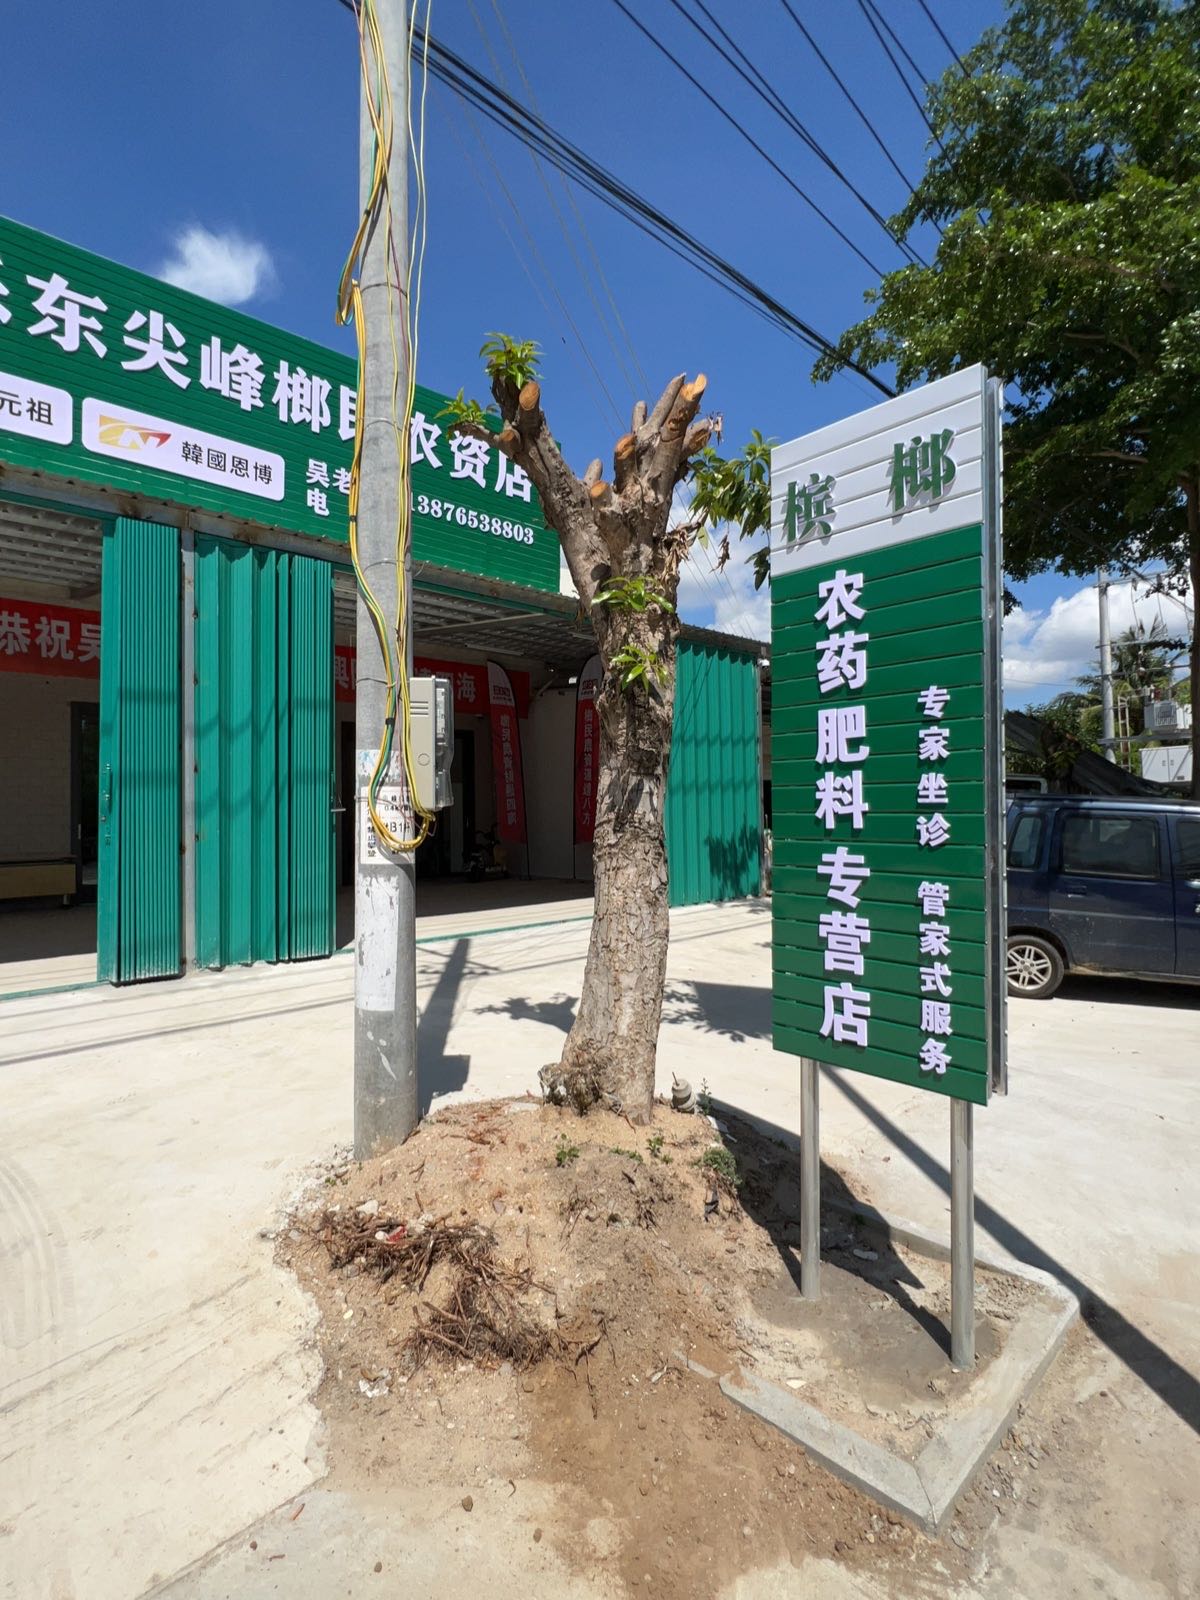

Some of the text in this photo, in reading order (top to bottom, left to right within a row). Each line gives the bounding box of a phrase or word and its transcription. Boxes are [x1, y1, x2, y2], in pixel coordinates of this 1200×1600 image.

[182, 440, 273, 486] 韓國恩博
[782, 428, 956, 542] 槟榔
[815, 569, 871, 1048] 农药肥料专营店
[916, 685, 953, 1075] 专家坐诊 管家式服务
